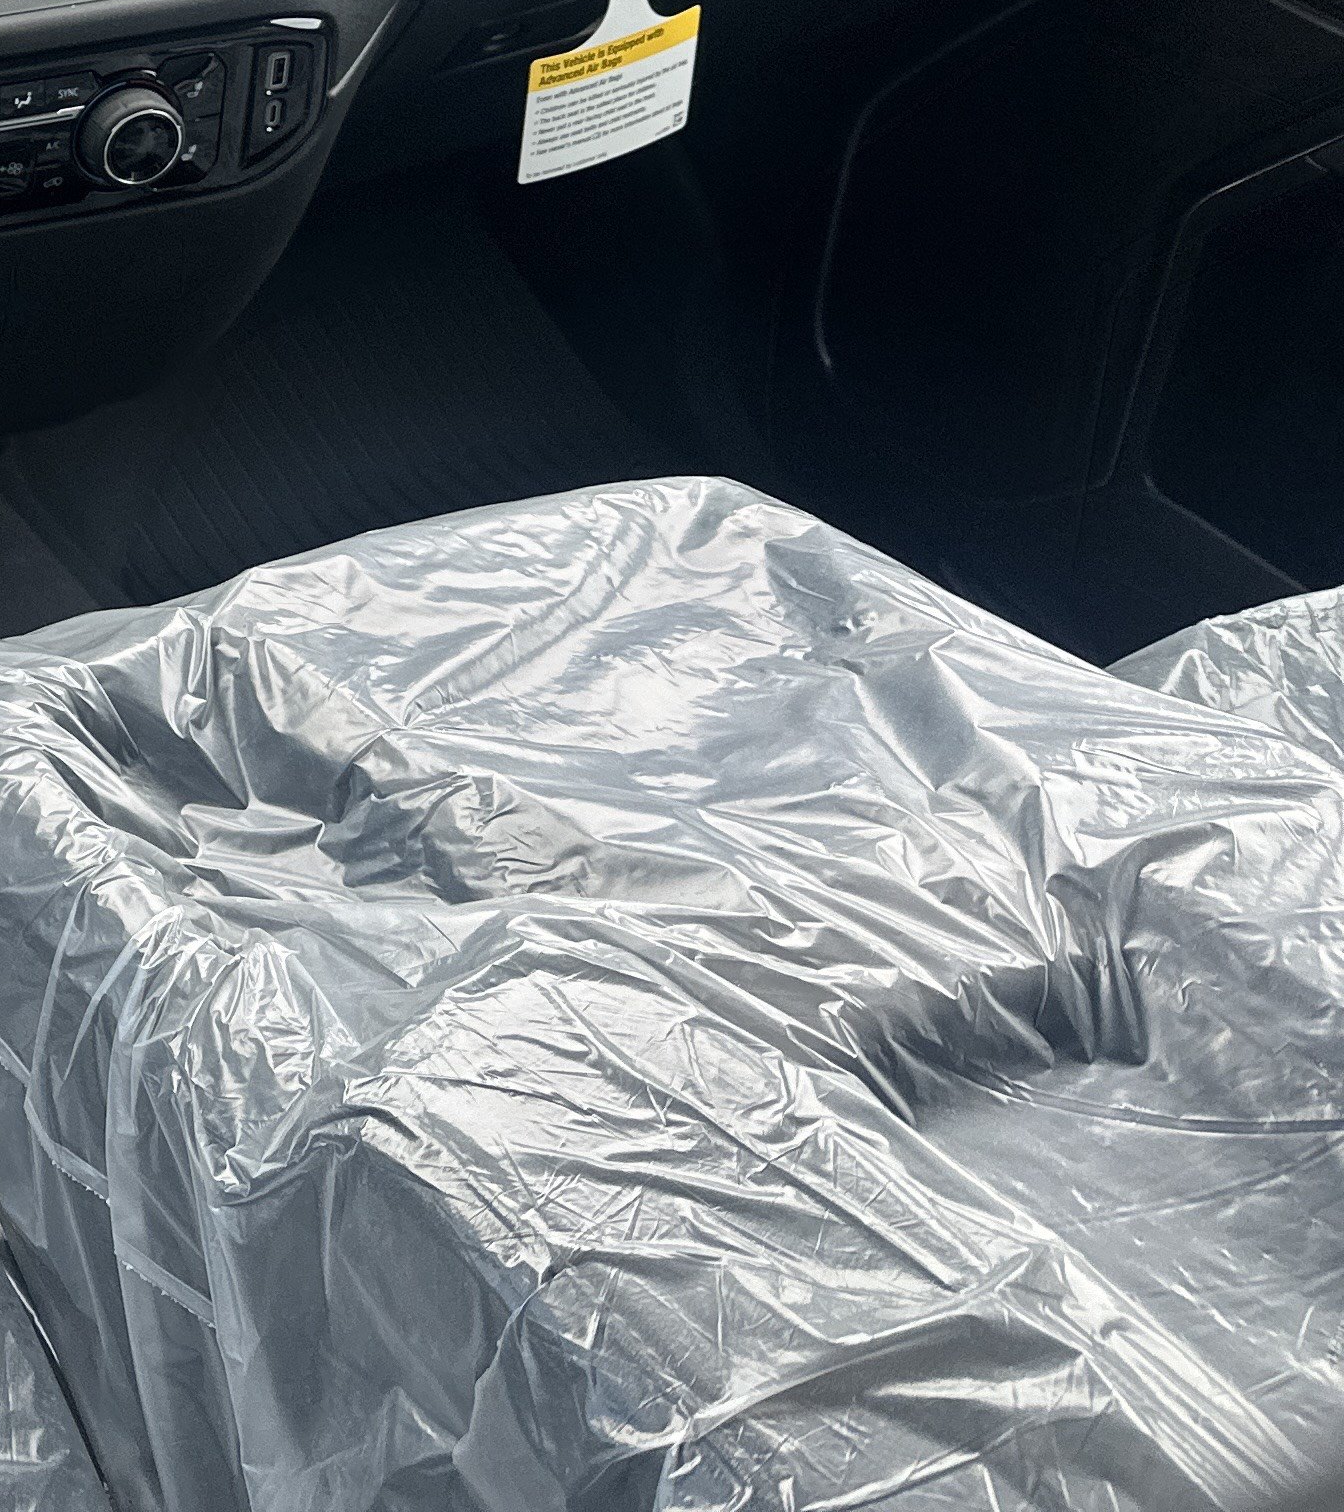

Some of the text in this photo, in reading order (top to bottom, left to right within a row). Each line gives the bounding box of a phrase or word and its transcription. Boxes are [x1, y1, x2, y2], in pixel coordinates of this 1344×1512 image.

[538, 55, 623, 87] Advanced Air Bags
[540, 62, 561, 74] This
[563, 52, 596, 69] Vehicle
[597, 49, 605, 58] is
[607, 34, 645, 55] Equipped
